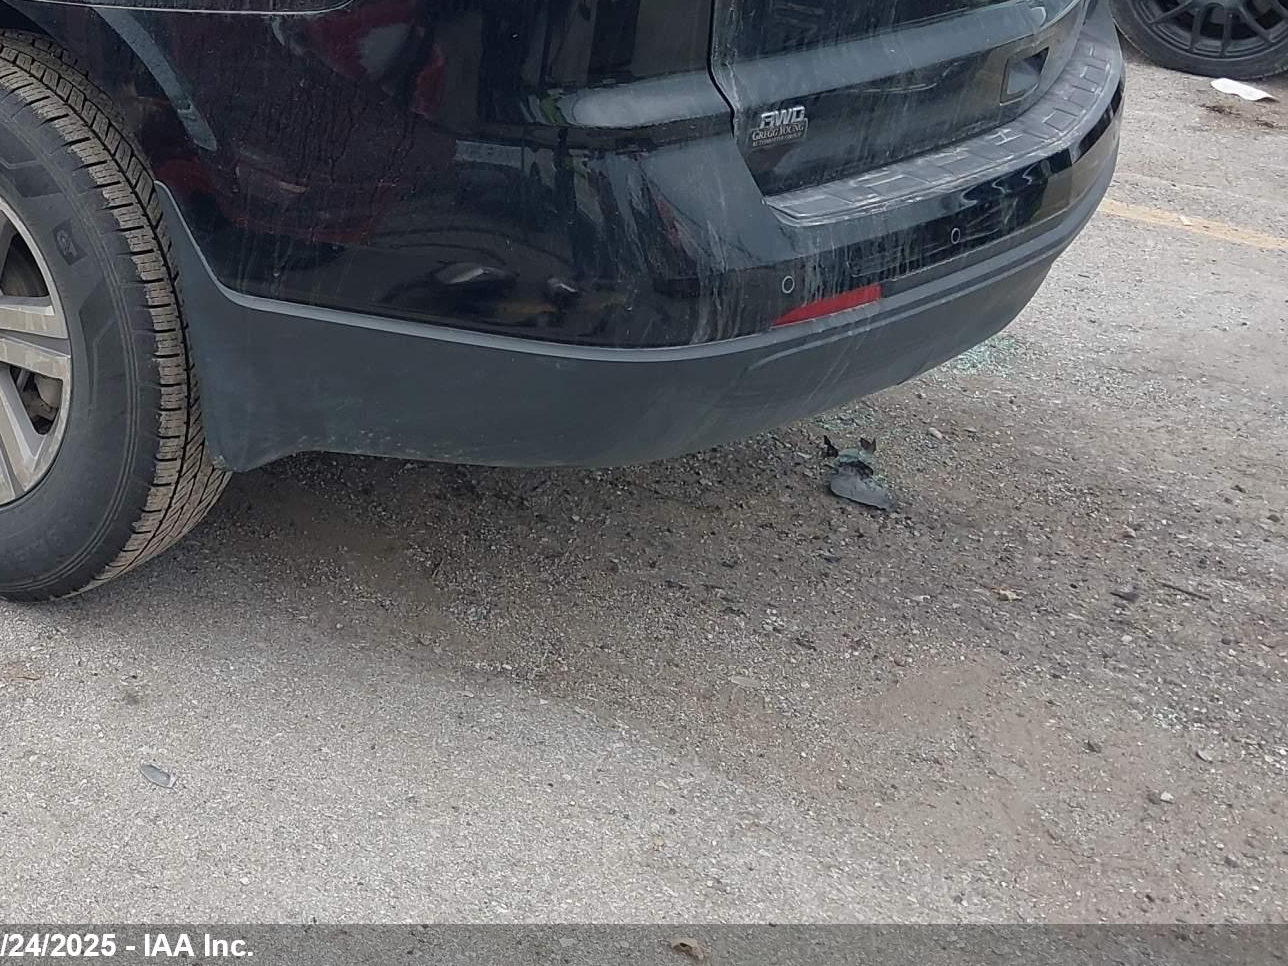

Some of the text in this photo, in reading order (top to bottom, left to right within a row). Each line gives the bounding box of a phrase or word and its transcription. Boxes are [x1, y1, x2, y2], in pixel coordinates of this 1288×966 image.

[760, 106, 806, 129] AWD
[752, 123, 804, 141] GREGG YOUNG
